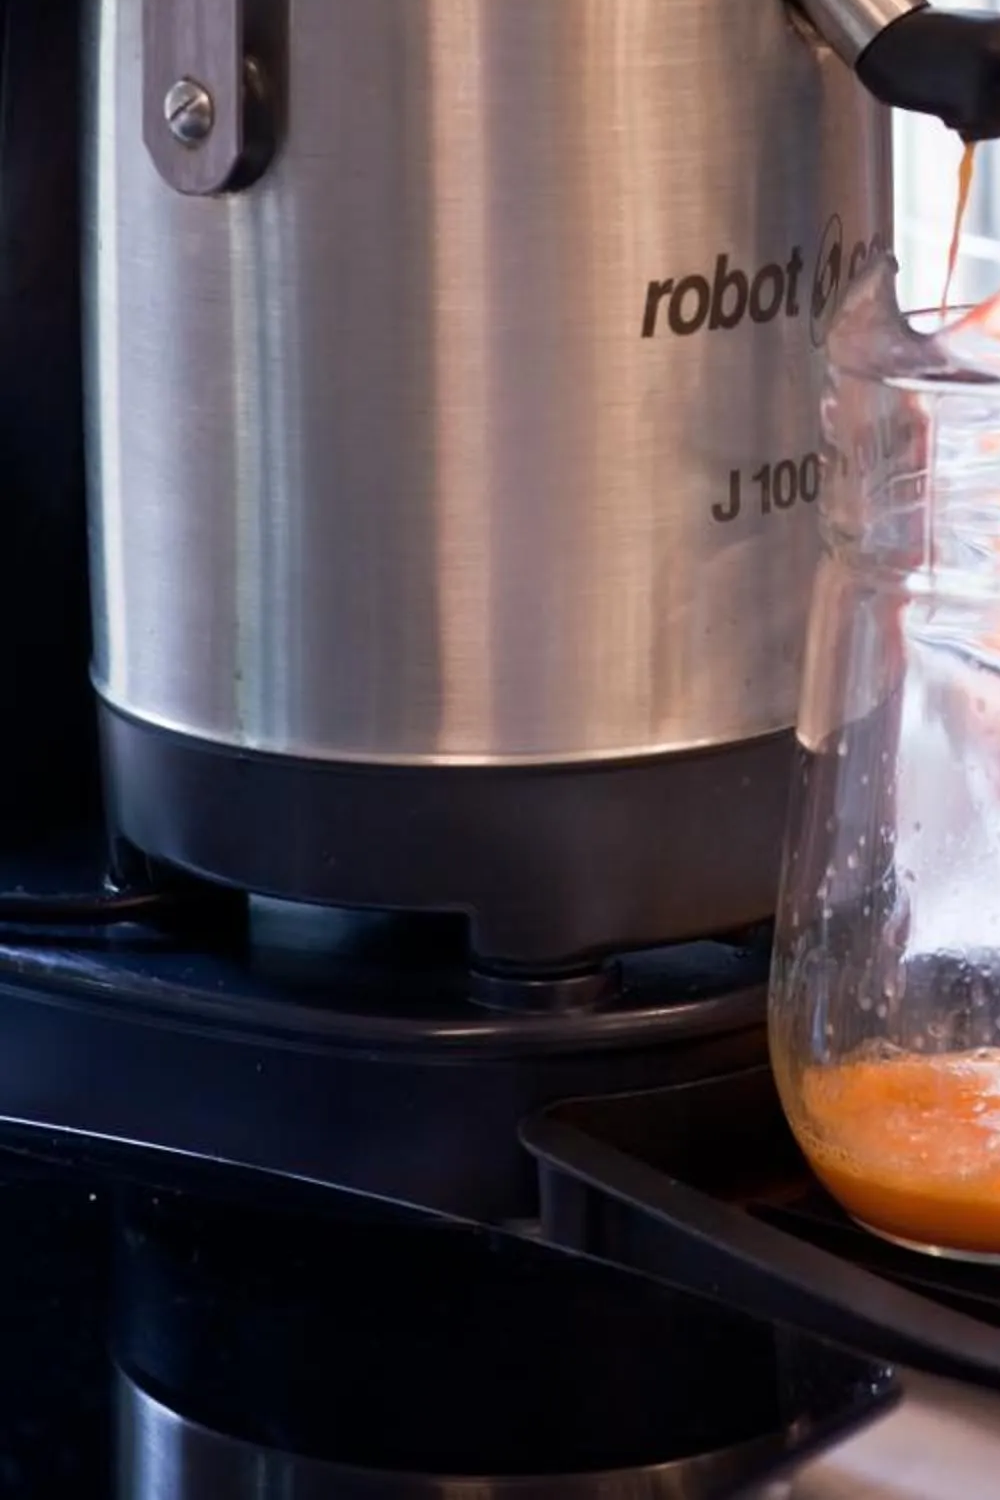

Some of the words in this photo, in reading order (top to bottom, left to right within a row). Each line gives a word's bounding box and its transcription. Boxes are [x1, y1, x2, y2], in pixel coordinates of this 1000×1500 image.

[641, 245, 803, 338] robot
[711, 469, 741, 523] J
[752, 452, 820, 516] 100
